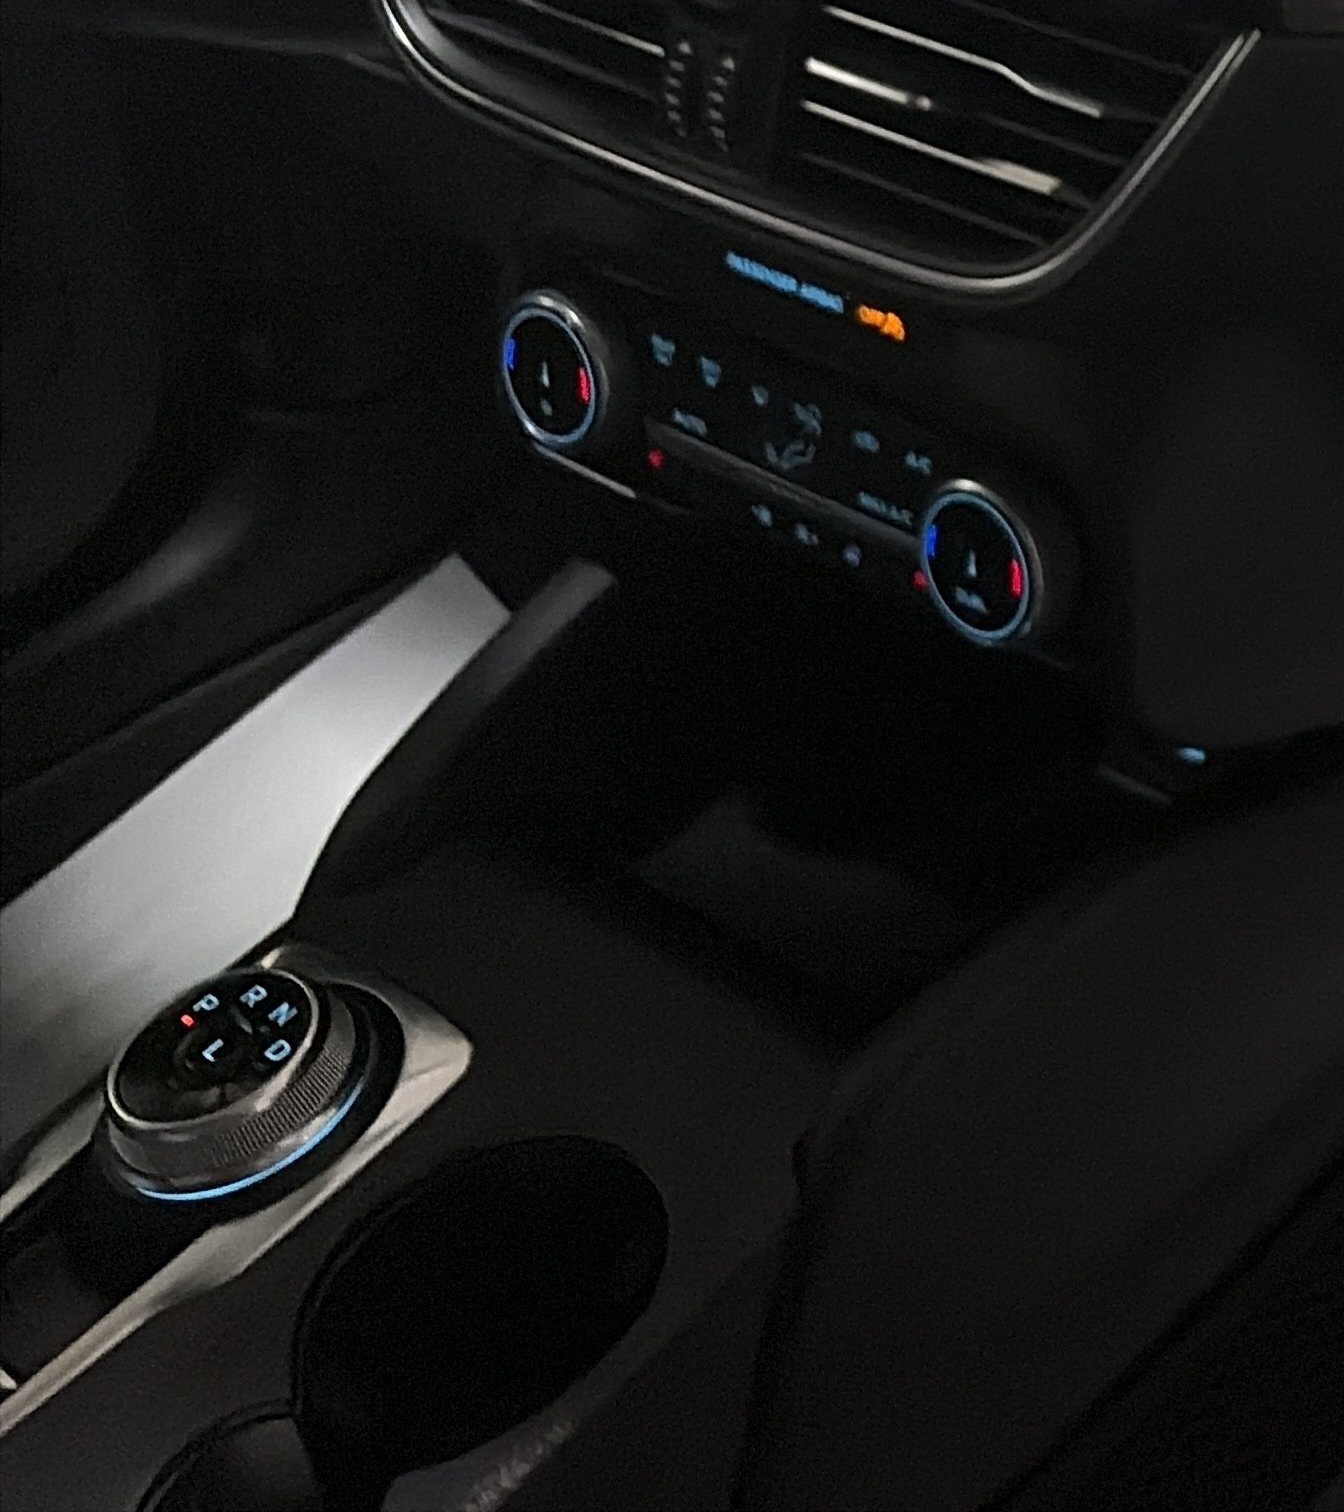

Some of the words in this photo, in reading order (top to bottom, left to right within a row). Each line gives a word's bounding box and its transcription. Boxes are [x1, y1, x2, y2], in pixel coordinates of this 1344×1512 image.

[192, 993, 220, 1012] P
[239, 984, 268, 1008] R
[267, 1001, 298, 1027] N
[202, 1038, 224, 1062] L
[264, 1039, 291, 1061] D
